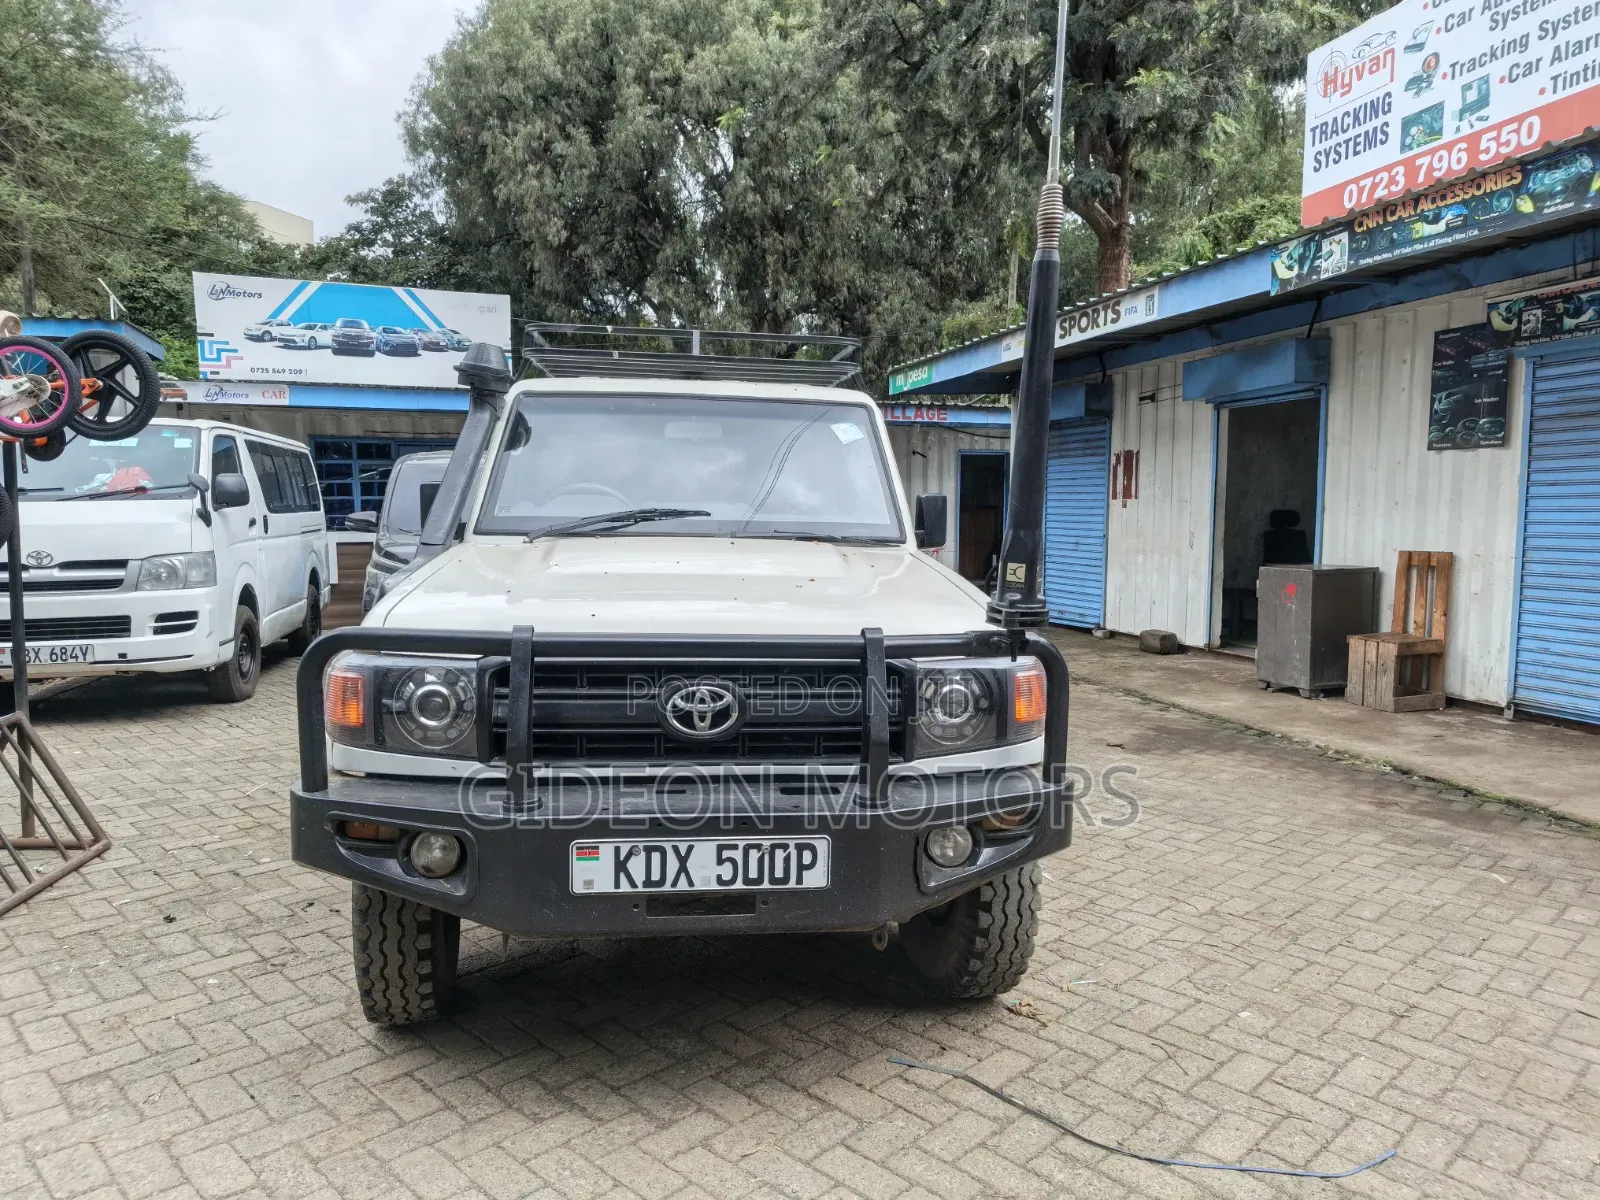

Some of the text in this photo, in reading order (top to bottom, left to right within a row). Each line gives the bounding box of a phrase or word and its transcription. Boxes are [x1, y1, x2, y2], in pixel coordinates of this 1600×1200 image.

[1444, 6, 1475, 33] Car
[1321, 47, 1396, 99] Hyvan
[1448, 32, 1530, 81] Tracking
[1508, 56, 1543, 84] Car
[1549, 59, 1600, 95] Tinti
[1310, 91, 1392, 148] TRACKING
[1313, 121, 1390, 173] SYSTEMS
[1343, 115, 1541, 209] 0723 796 550
[1354, 165, 1523, 233] CNN CAR ACCESSORIES
[227, 288, 263, 299] Motors
[1058, 300, 1138, 340] SPORTS FIFA
[219, 390, 250, 399] Motors
[261, 390, 287, 399] CAR
[884, 406, 948, 421] ILLAGE
[49, 645, 89, 663] 684Y
[613, 844, 695, 890] KDX
[715, 842, 819, 887] 500P
